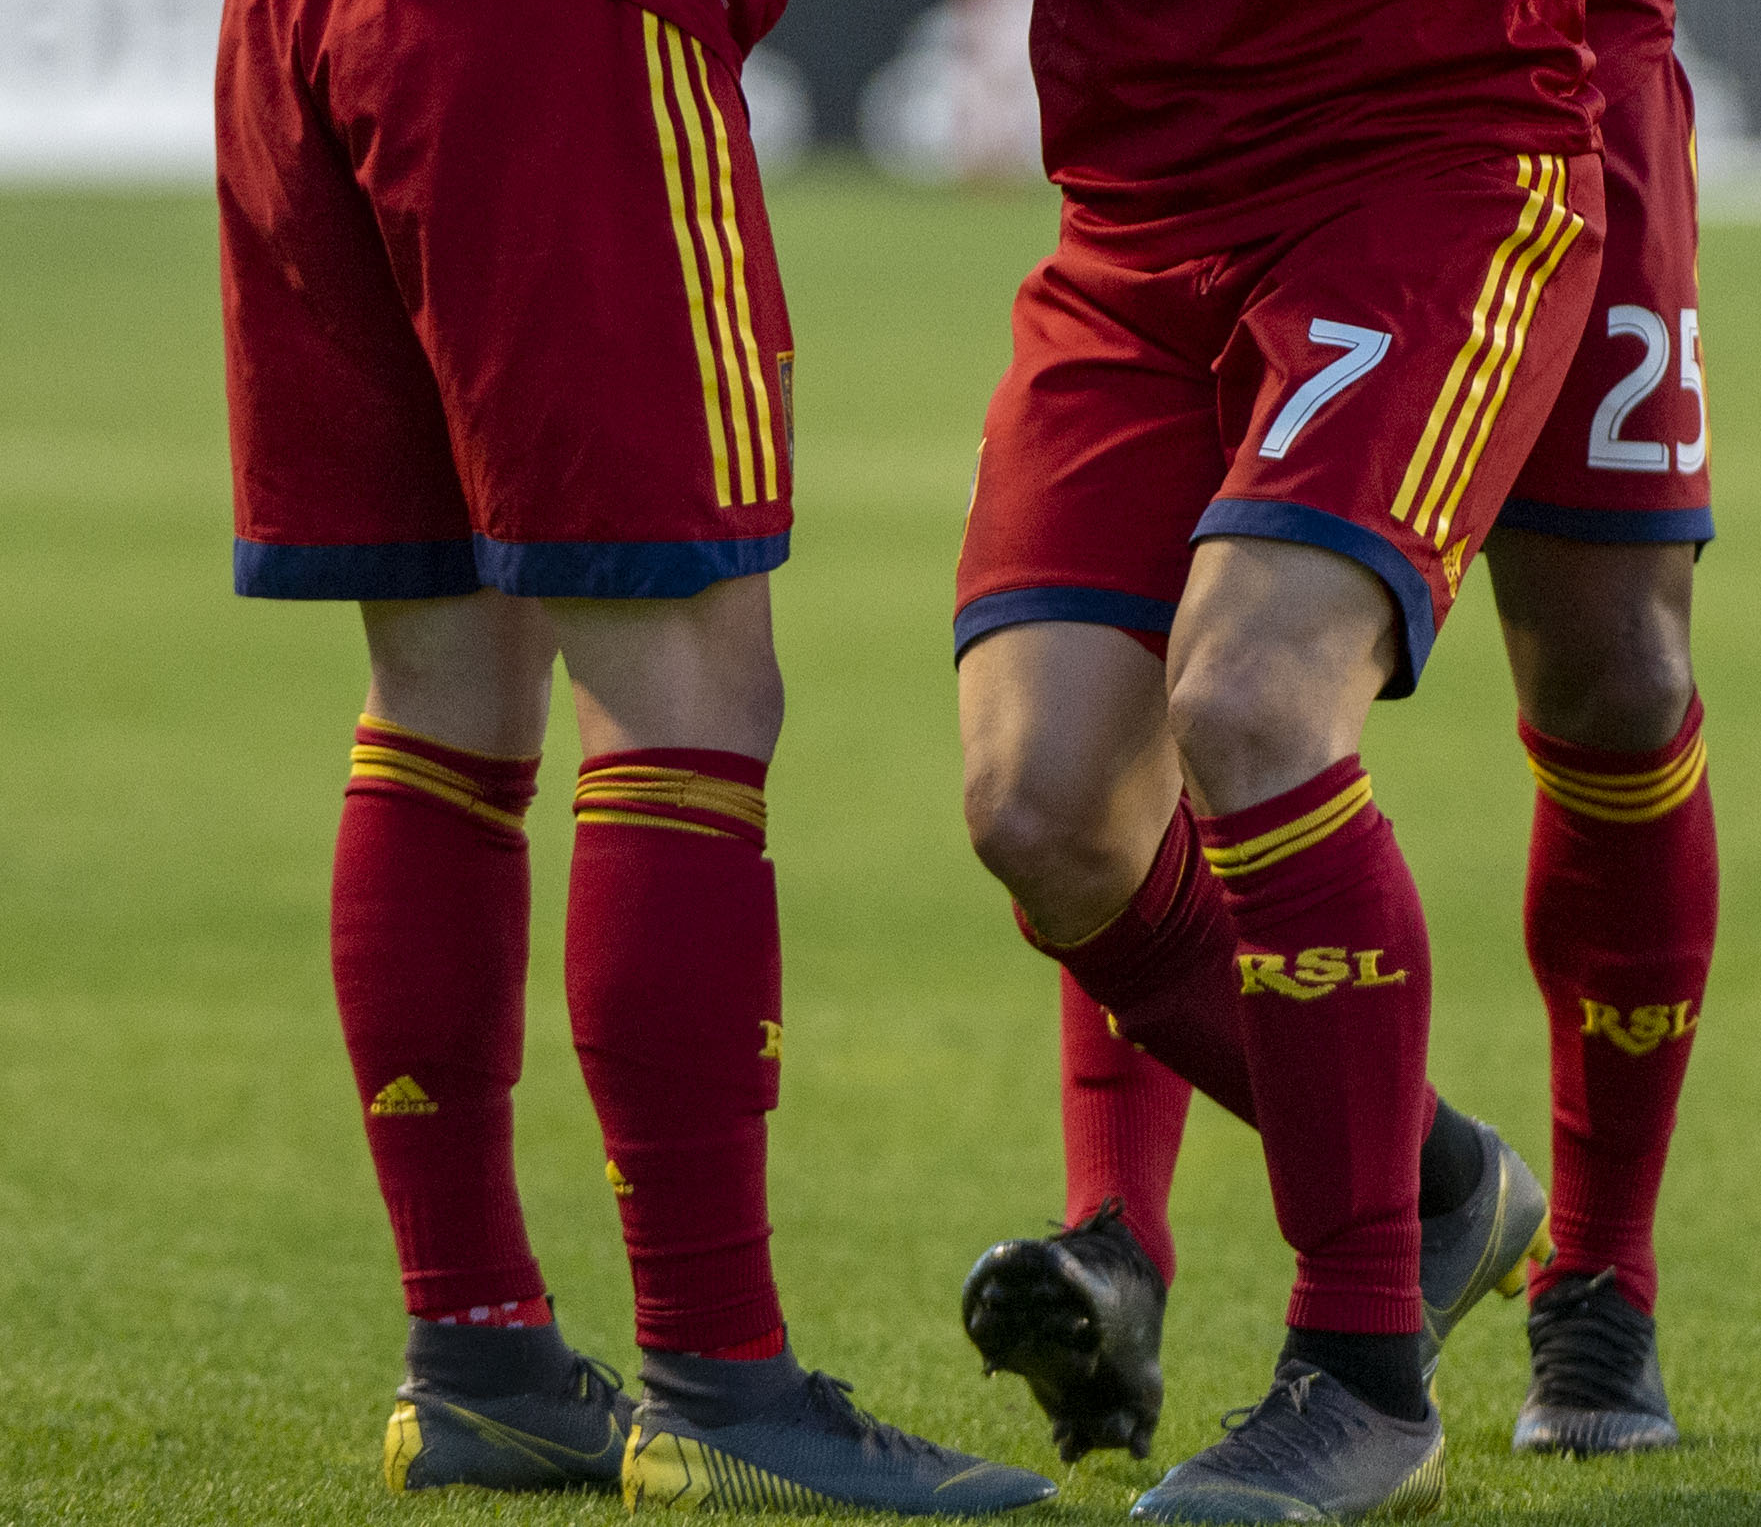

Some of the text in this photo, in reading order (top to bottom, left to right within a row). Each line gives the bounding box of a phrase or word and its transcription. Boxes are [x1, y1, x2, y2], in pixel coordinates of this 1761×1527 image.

[1258, 317, 1393, 460] 7
[1587, 304, 1707, 474] 25
[1237, 946, 1409, 1001] RSL
[1579, 997, 1699, 1055] RSL
